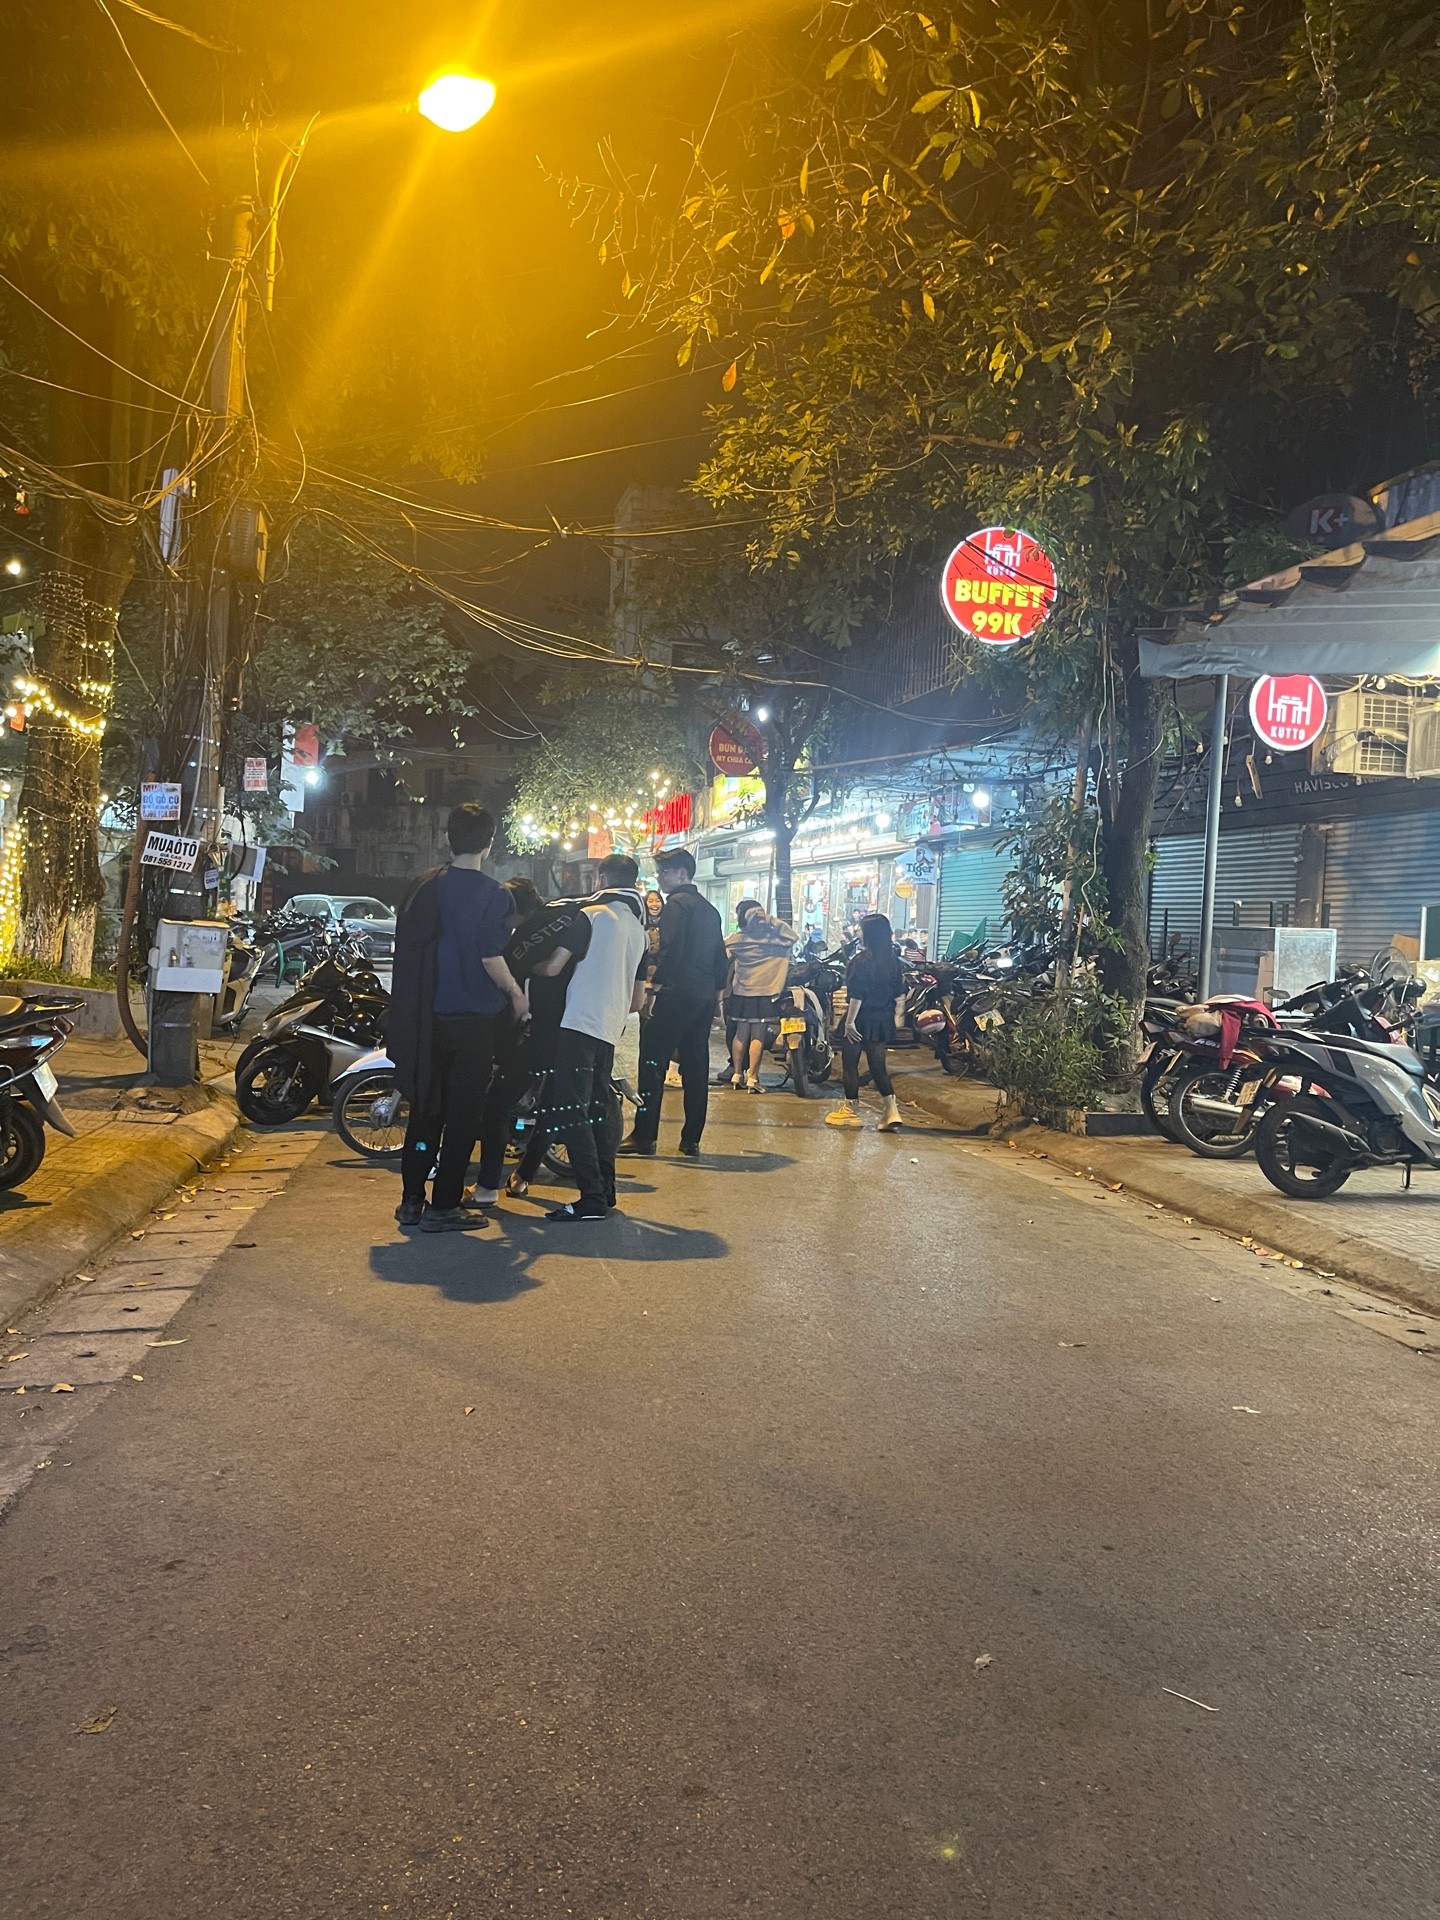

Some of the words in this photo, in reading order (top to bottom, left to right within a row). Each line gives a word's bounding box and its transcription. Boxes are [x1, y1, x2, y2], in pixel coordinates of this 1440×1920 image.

[954, 578, 1045, 609] BUFFET
[971, 610, 1022, 636] 99K
[1270, 725, 1306, 741] KUTTO
[906, 862, 934, 877] Tiger
